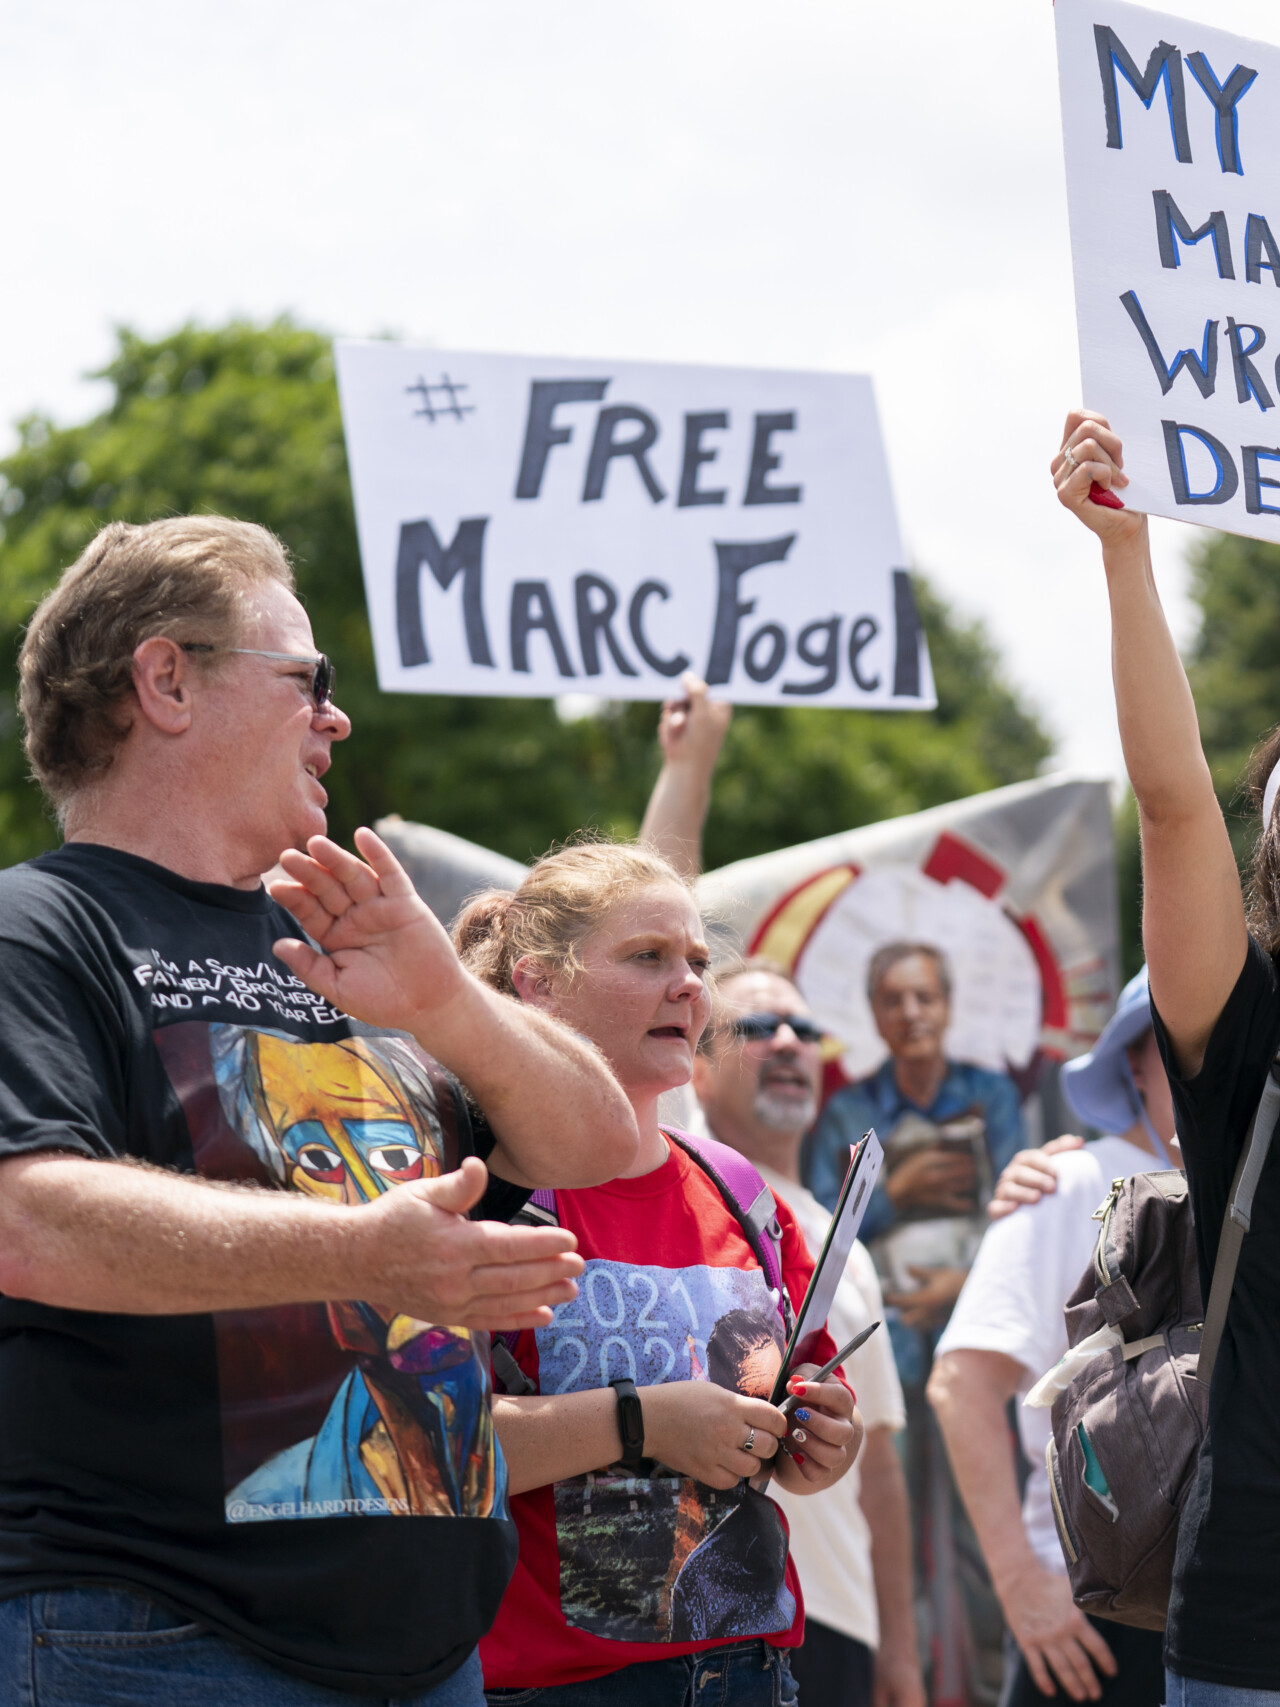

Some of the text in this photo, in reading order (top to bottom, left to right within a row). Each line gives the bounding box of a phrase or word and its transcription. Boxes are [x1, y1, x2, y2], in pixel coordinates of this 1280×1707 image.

[1093, 24, 1258, 176] MY
[512, 377, 803, 508] FREE
[395, 517, 925, 697] MARC Fogel
[133, 963, 325, 1006] FATHER/ BROTHER/
[151, 948, 307, 988] I'M A SON/HUS
[151, 992, 193, 1009] AND
[225, 990, 261, 1011] 40
[266, 998, 311, 1024] YEAR
[225, 1498, 409, 1522] @ENGELHARDTDESIGNS
